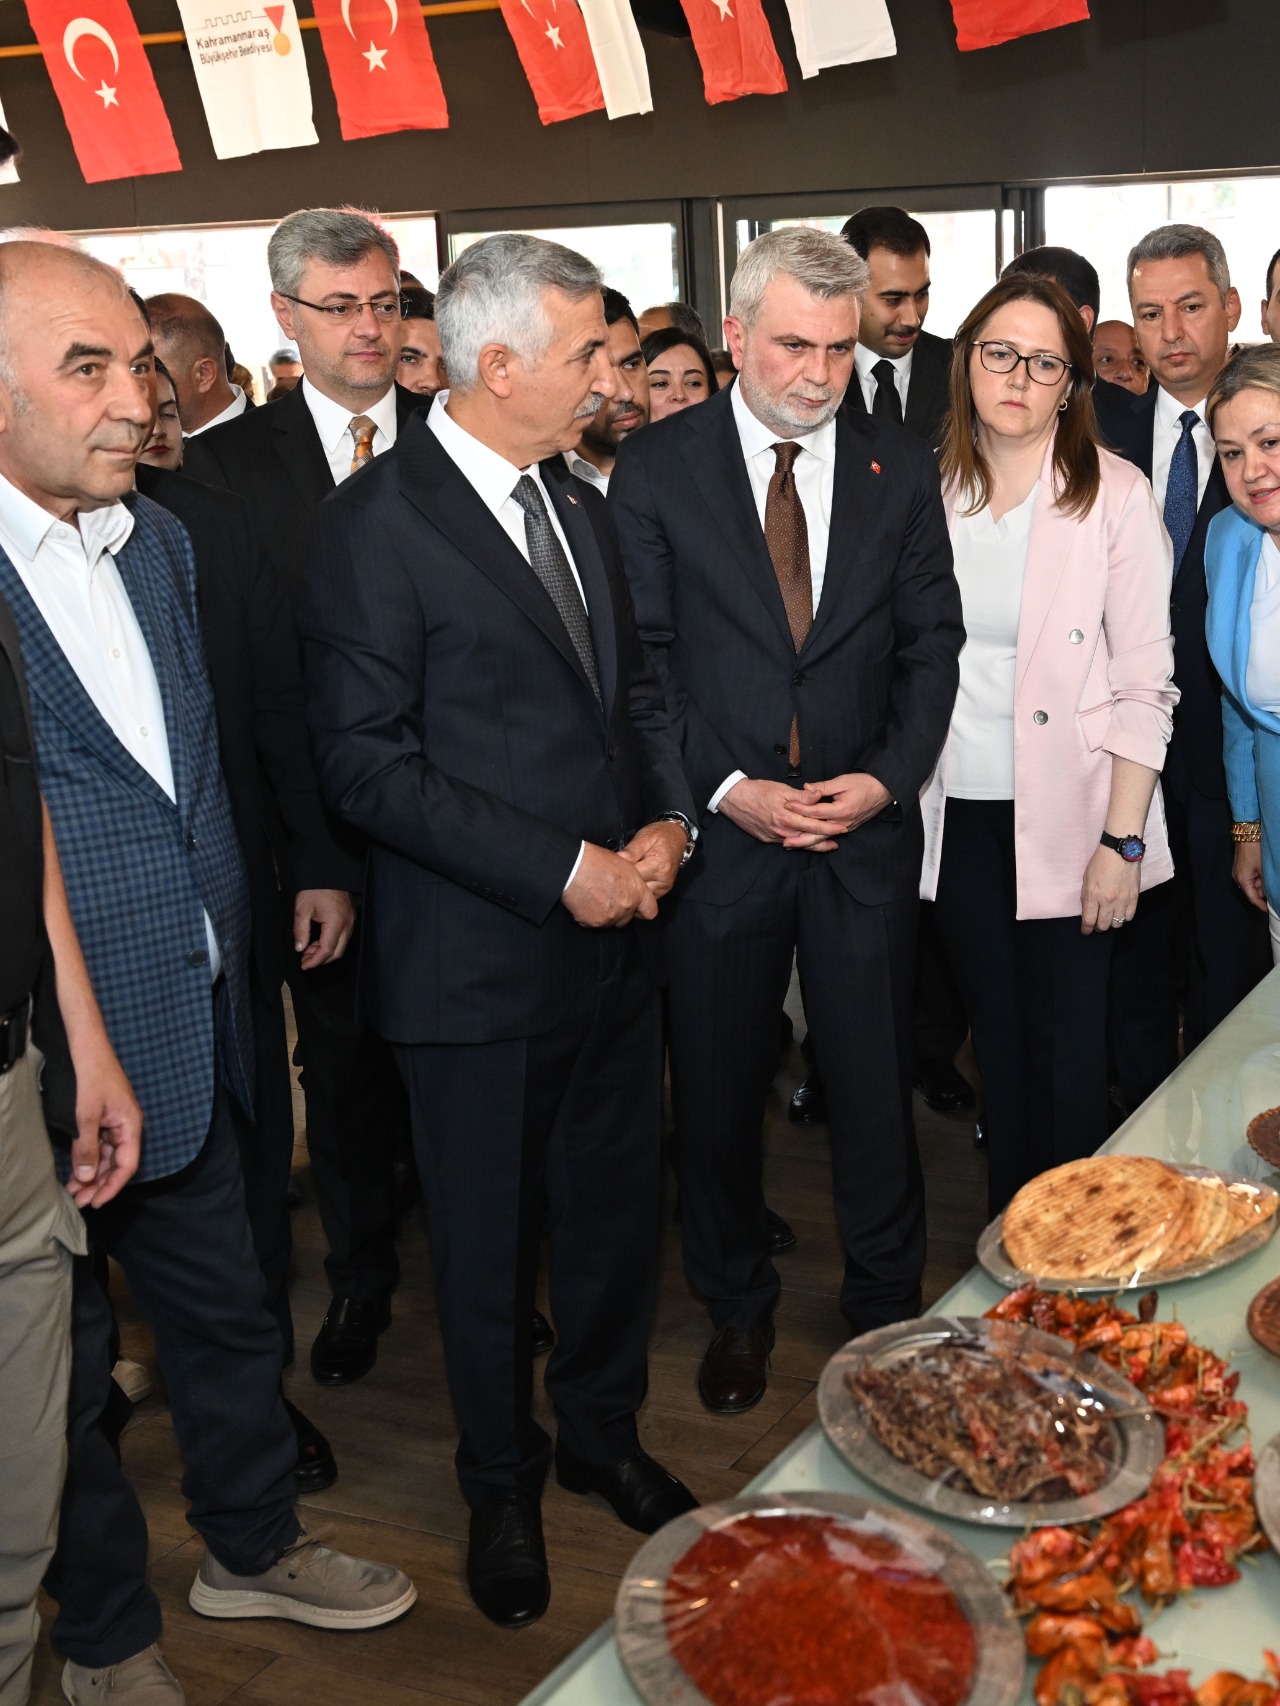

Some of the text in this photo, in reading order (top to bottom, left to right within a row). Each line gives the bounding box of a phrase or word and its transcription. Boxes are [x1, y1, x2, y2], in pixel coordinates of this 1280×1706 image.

[195, 28, 270, 49] Kahramanmaraş
[200, 41, 273, 65] Büyükşehir Belediyesi
